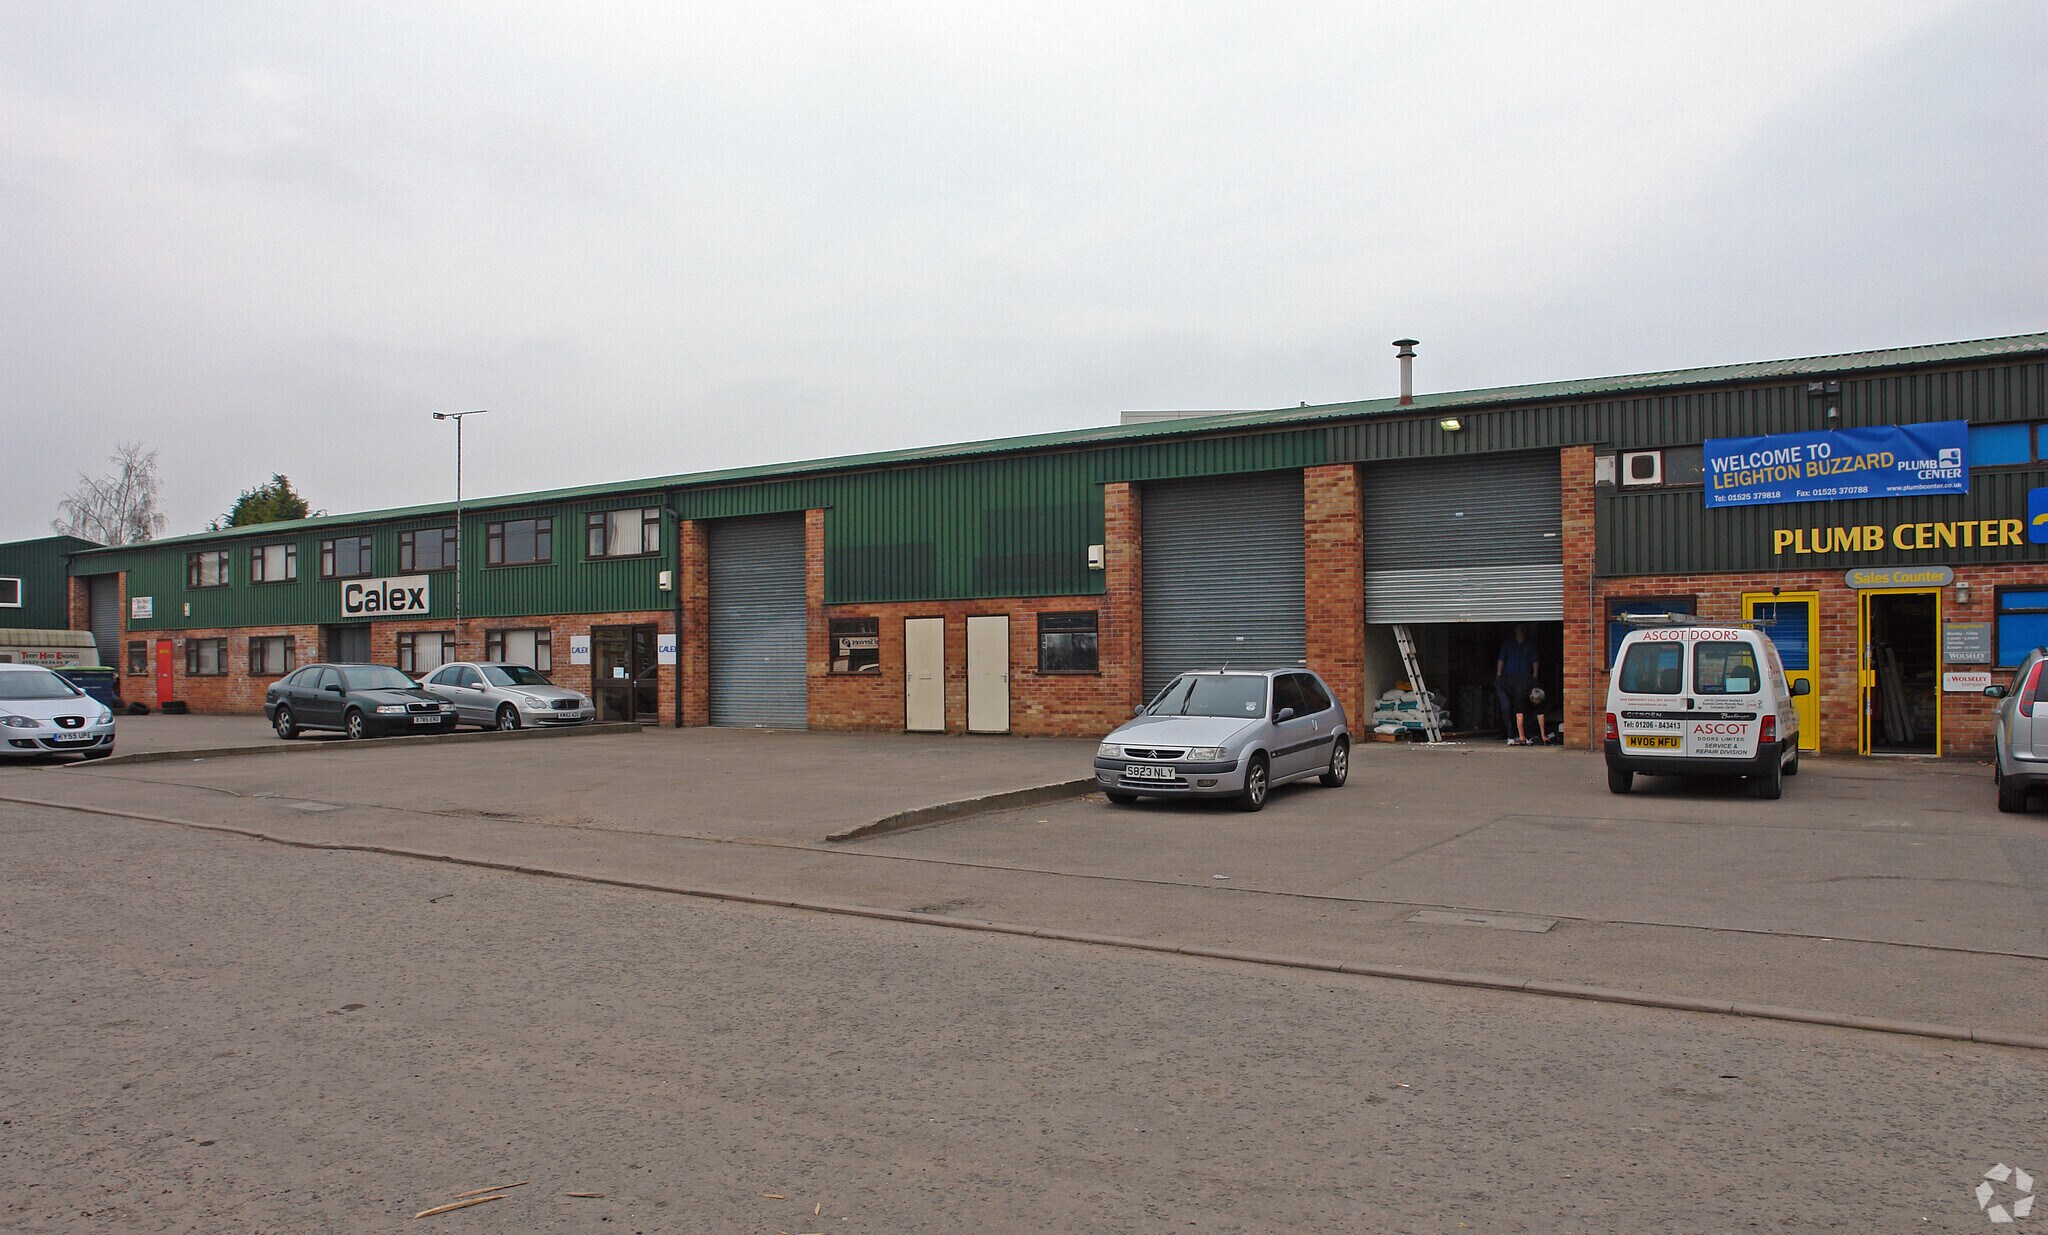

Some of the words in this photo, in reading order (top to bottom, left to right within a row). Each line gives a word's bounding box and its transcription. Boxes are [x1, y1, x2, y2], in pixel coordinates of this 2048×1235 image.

[1711, 447, 1801, 473] WELCOME
[1807, 443, 1831, 460] TO
[1713, 463, 1801, 490] LEIGHTON
[1806, 452, 1894, 478] BUZZARD
[1897, 460, 1937, 471] PLUMB
[1918, 468, 1962, 480] CENTER
[1812, 487, 1837, 496] 01525
[1839, 486, 1868, 495] 370788
[1887, 482, 1962, 491] www.plumbcenter.co.uk
[1728, 494, 1751, 502] 01525
[1753, 491, 1781, 500] 379818
[1774, 525, 1885, 555] PLUMB
[1892, 518, 2024, 550] CENTER
[1853, 571, 1890, 585] Sales
[1892, 570, 1945, 583] Counter
[345, 581, 425, 613] Calex
[1643, 630, 1687, 641] ASCOT
[1690, 630, 1739, 641] DOORS
[1693, 723, 1748, 735] ASCOT
[1630, 737, 1656, 746] MV06
[1657, 738, 1677, 747] MFU
[1127, 766, 1152, 777] S823
[1153, 767, 1174, 778] NLY
